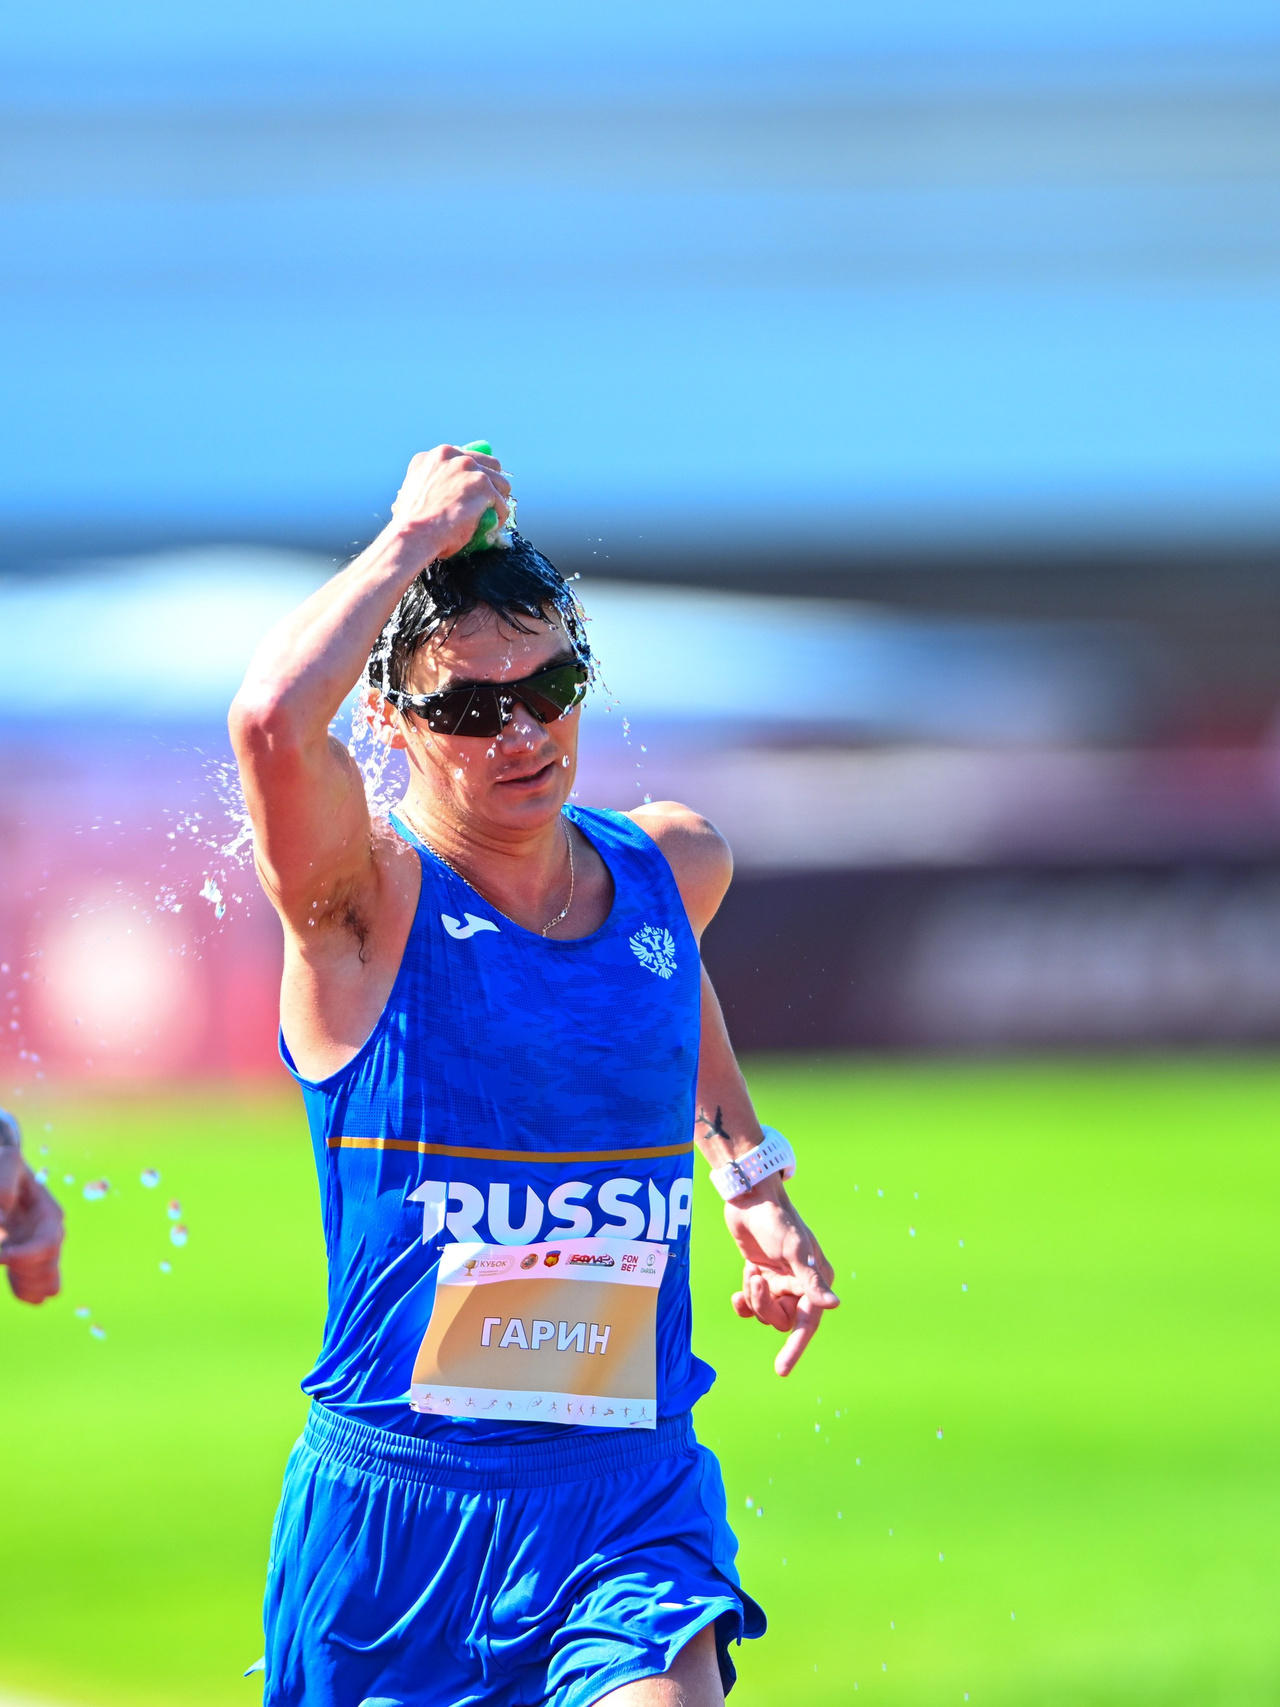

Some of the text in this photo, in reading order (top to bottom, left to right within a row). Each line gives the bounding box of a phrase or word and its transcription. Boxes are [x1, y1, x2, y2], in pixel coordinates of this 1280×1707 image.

[406, 1176, 693, 1246] RUSSIA
[480, 1260, 508, 1268] КУБОК
[621, 1254, 639, 1264] FON
[621, 1263, 637, 1272] BET
[480, 1316, 612, 1355] ГАРИН
